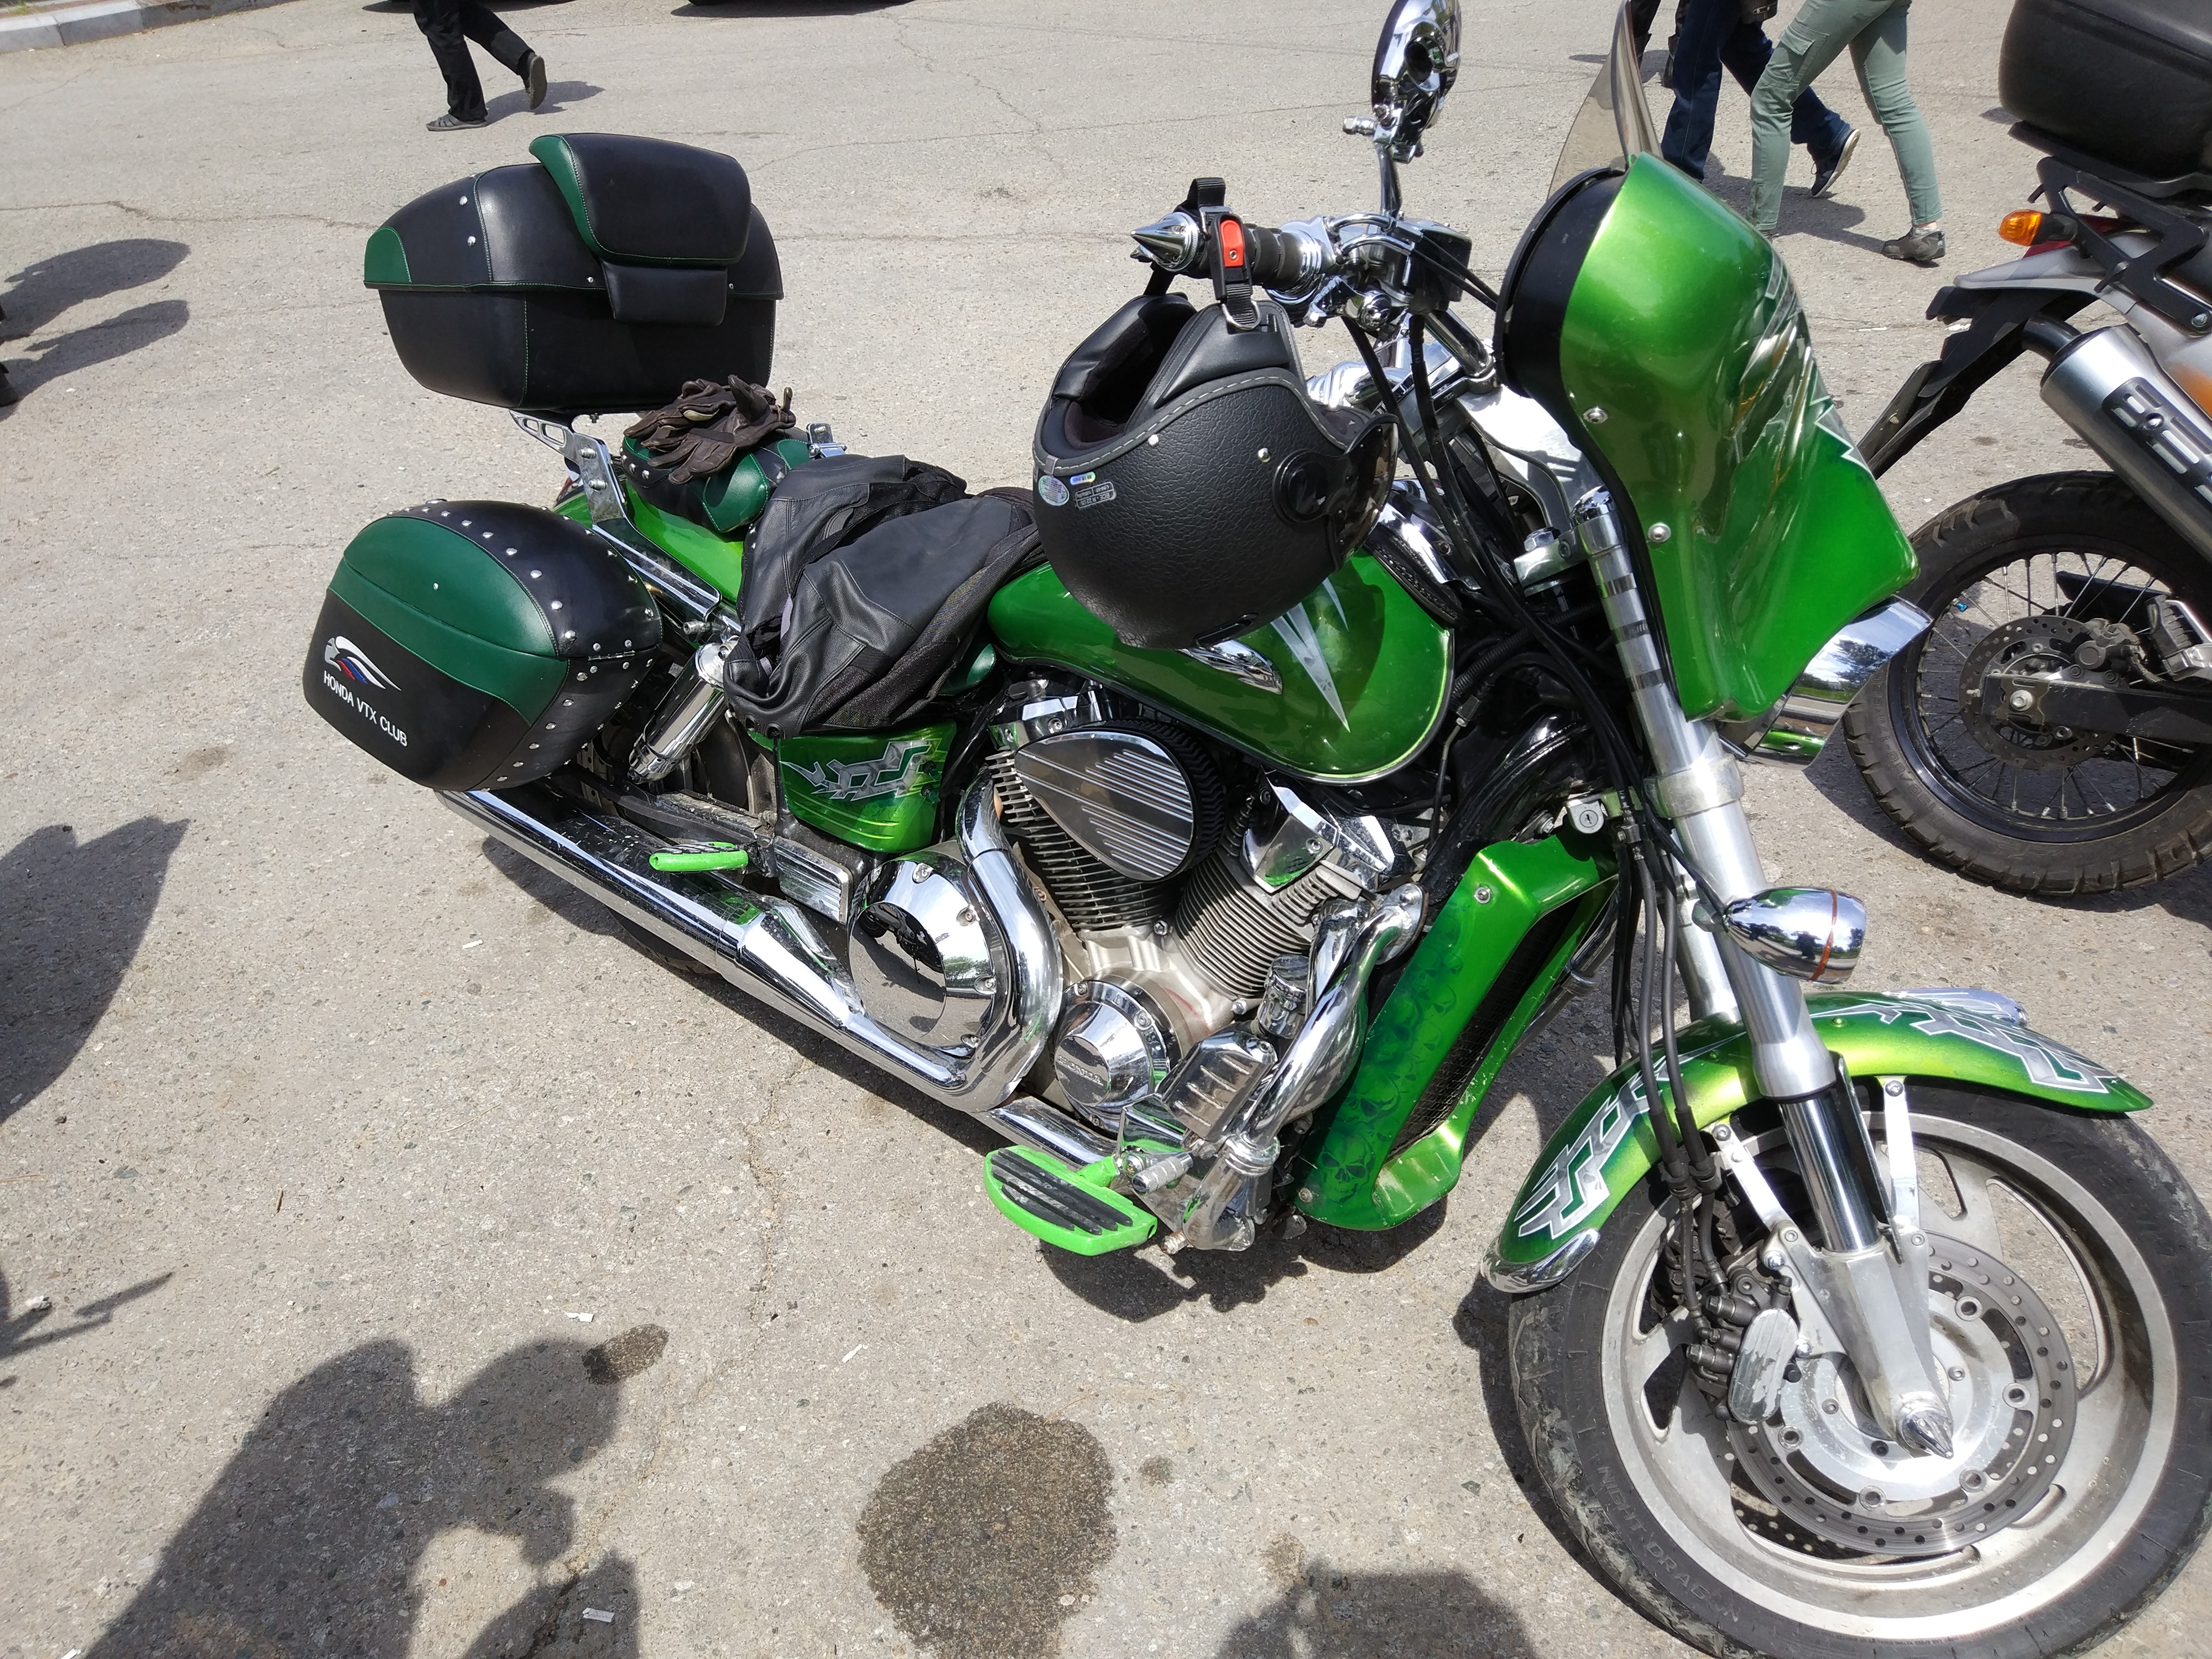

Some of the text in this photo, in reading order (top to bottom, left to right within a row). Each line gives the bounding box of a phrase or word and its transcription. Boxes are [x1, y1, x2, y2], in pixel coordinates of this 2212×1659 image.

[323, 670, 408, 747] HONDA VTX CLUB
[1057, 1054, 1104, 1087] HONDA
[1597, 1466, 1647, 1532] NIGHT
